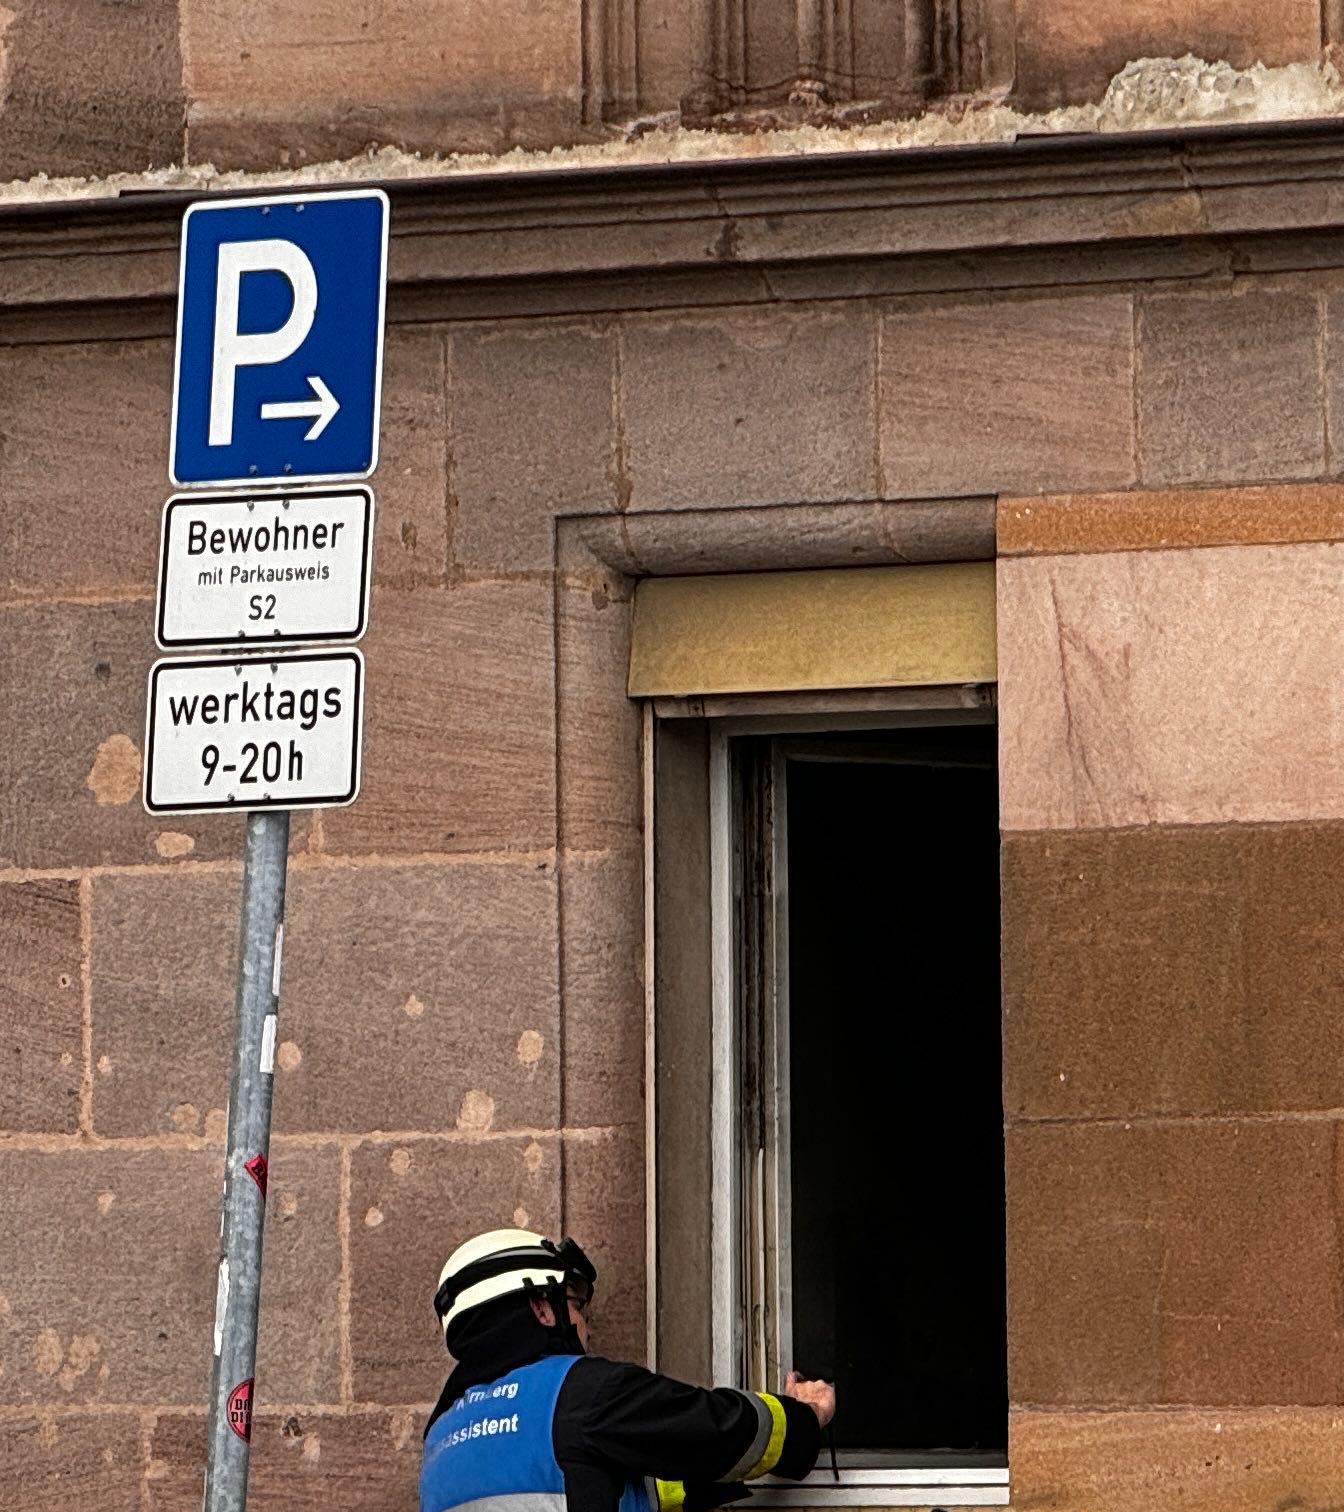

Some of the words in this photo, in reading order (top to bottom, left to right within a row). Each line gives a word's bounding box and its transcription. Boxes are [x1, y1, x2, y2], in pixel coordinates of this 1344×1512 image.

[207, 238, 318, 447] P
[187, 515, 345, 556] Bewohner
[198, 566, 223, 586] mit
[229, 560, 330, 585] Parkausweis
[248, 593, 277, 621] S2
[168, 680, 342, 731] werktags
